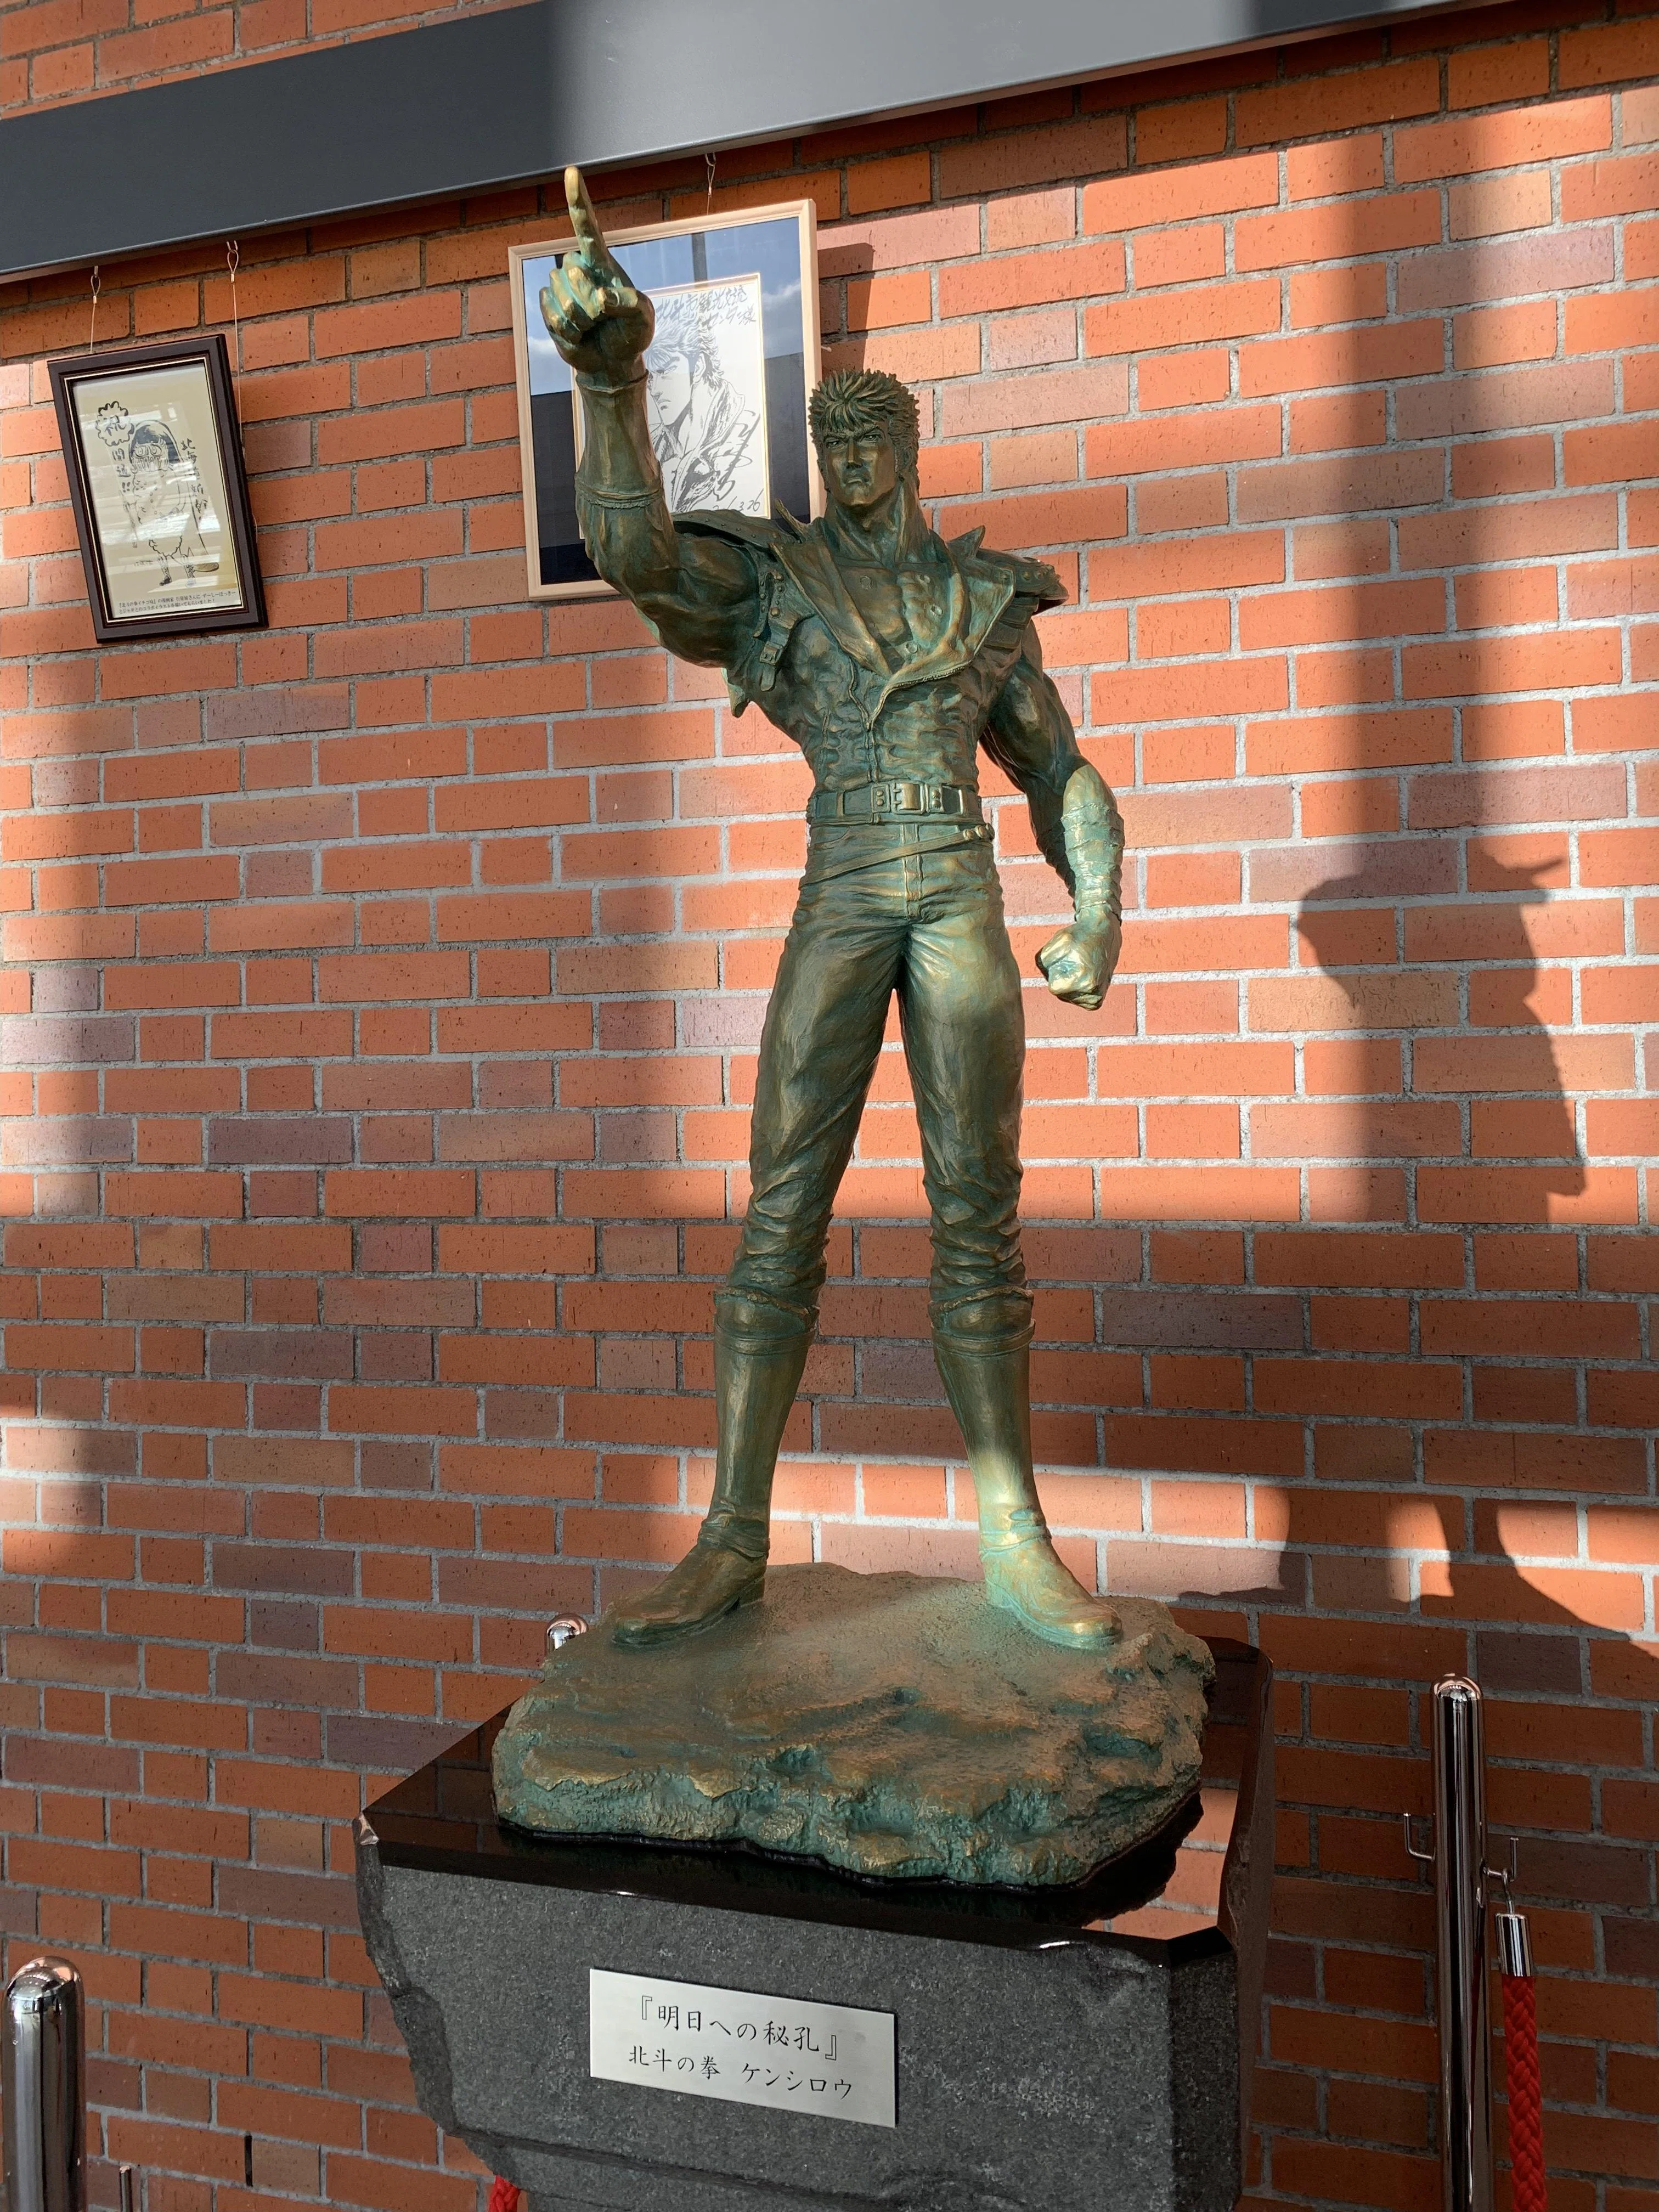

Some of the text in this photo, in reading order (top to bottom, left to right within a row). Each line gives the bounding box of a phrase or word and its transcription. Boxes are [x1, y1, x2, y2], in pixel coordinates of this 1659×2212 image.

[641, 1995, 837, 2061] 『明日への秘孔』
[629, 2045, 852, 2100] 北斗の拳 ケンシロウ
